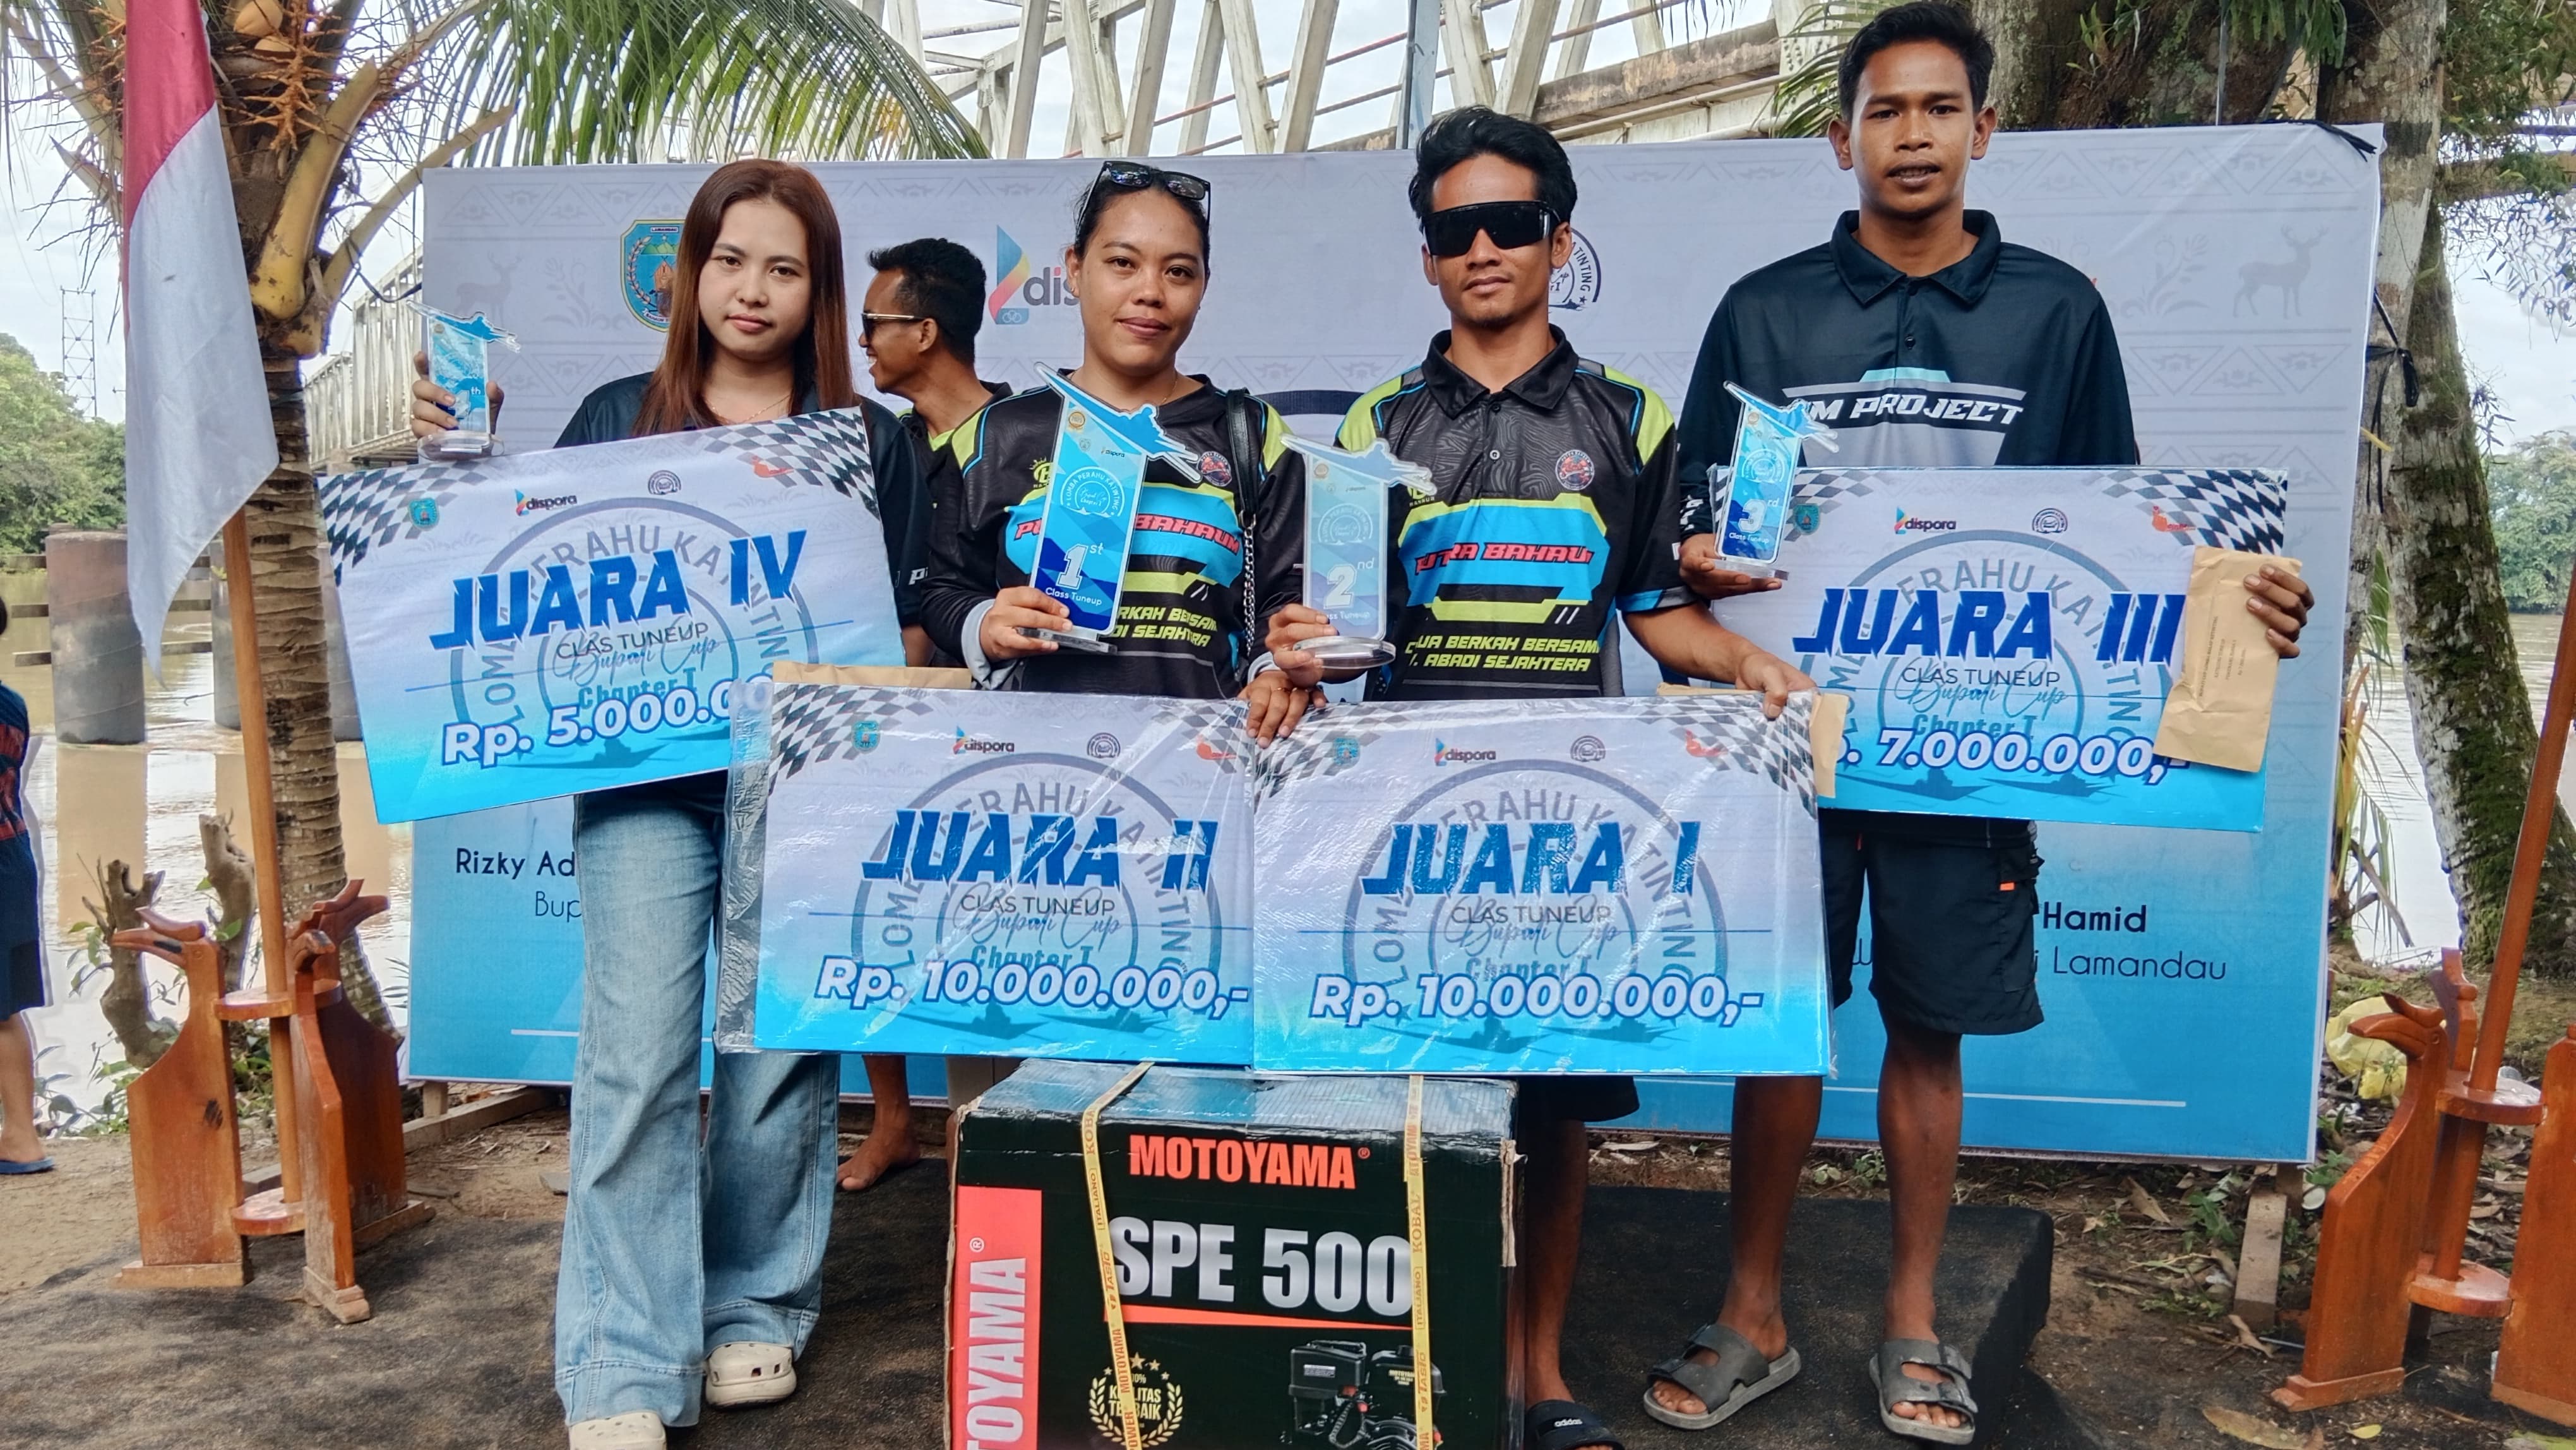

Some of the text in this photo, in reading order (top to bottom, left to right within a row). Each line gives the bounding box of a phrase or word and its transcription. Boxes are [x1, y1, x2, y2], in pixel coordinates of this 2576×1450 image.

[1849, 393, 2023, 425] PROJECT
[526, 494, 577, 510] dispora
[1135, 513, 1241, 555] BAHAUM
[1905, 518, 1956, 534] dispora
[430, 530, 807, 650] JUARA IV
[1045, 586, 1102, 607] Class Tuneup
[556, 621, 709, 661] CLAS TUNEUP
[1445, 635, 1520, 650] BERKAH
[1792, 588, 2186, 667] JUARA III
[1423, 654, 1482, 668] ABADI
[1482, 654, 1591, 672] SEJAHTERA
[1903, 667, 2060, 687] CLAS TUNEUP
[441, 722, 534, 769] Rp.
[964, 738, 1015, 753] dispora
[1445, 748, 1496, 762] dispora
[455, 847, 526, 880] Rizky
[861, 808, 1219, 894] JUARA II
[1361, 820, 1702, 897] JUARA I
[961, 894, 1116, 916] CLAS TUNEUP
[1452, 906, 1611, 924] CLAS TUNEUP
[2042, 902, 2147, 933] Hamid
[2053, 945, 2227, 980] Lamandau
[814, 954, 1249, 1021] Rp. 10.000.000,-
[1308, 971, 1763, 1028] Rp. 10.000.000,-
[1109, 1216, 1414, 1317] SPE 500
[1090, 1172, 1104, 1226] ITALIANO
[1112, 1328, 1131, 1394] MOTOYAMA
[1124, 1411, 1140, 1450] OWER
[1414, 1270, 1424, 1327] ITALIANO
[1554, 1418, 1583, 1428] adidas
